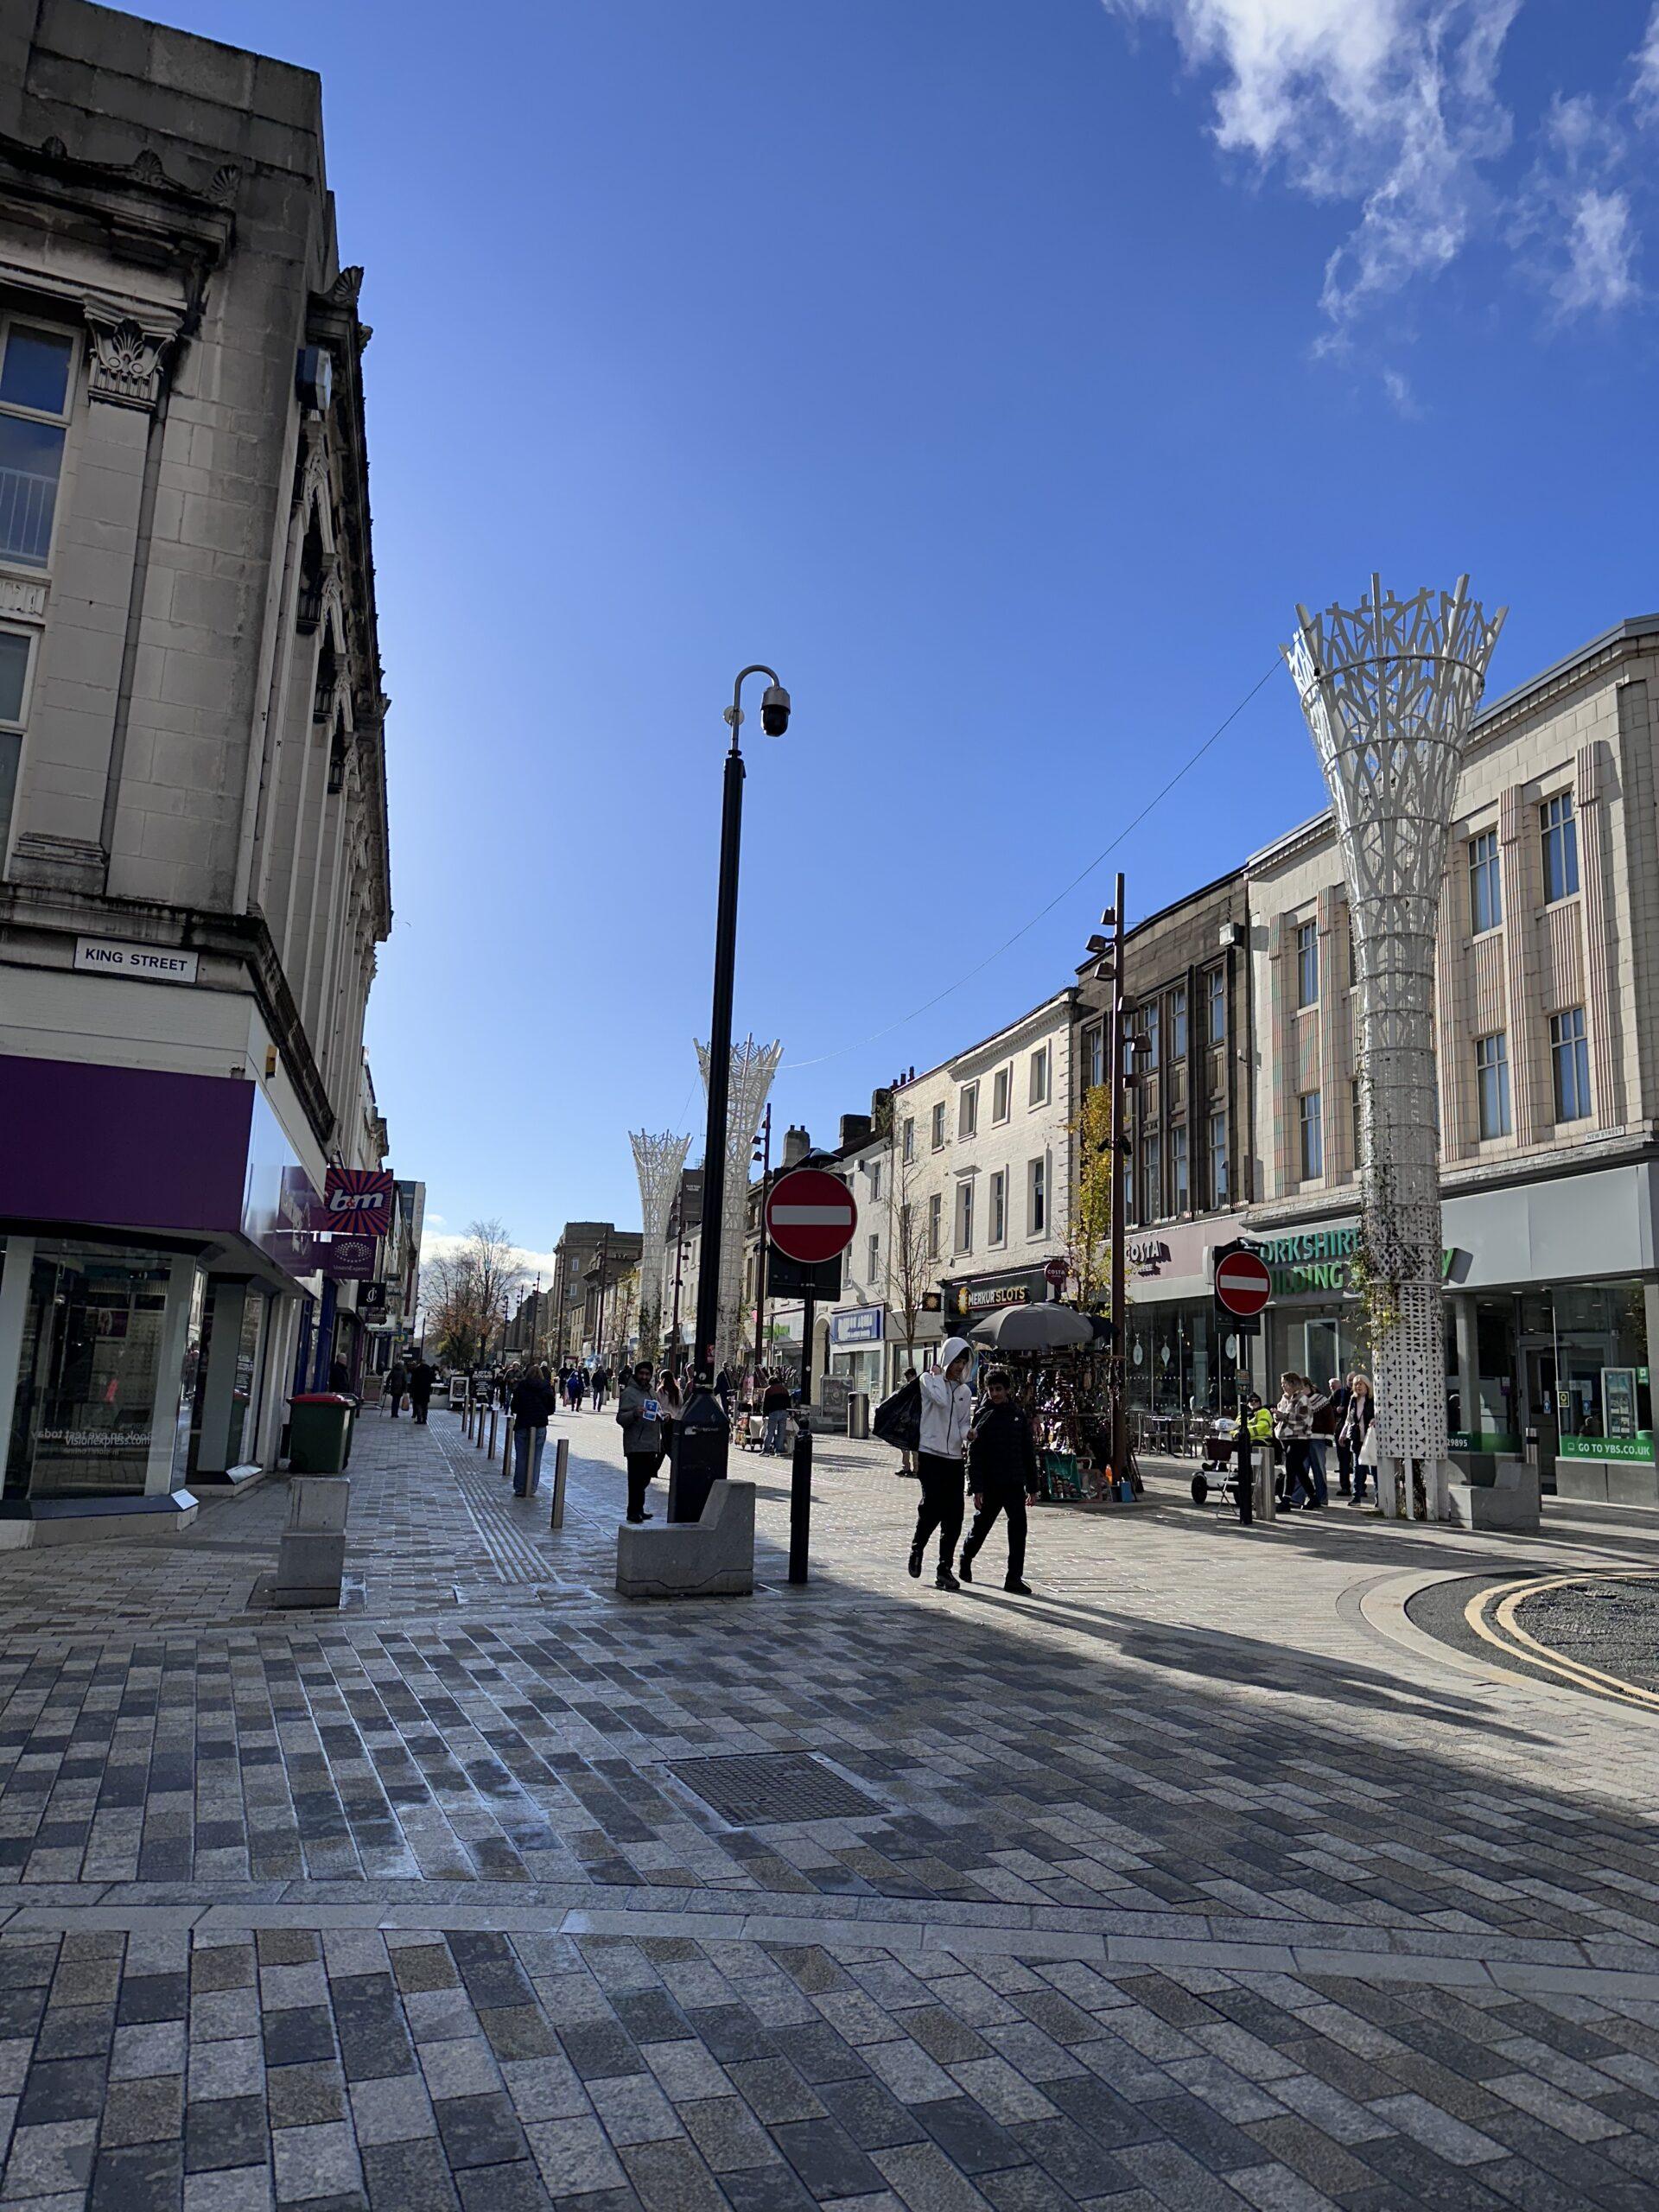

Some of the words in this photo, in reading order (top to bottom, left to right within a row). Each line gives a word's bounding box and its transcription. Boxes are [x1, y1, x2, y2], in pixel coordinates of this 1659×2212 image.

[86, 948, 123, 963] KING
[130, 954, 188, 971] STREET
[1600, 1128, 1623, 1138] STREET
[329, 1189, 384, 1211] b&m
[1124, 1240, 1161, 1262] COSTA
[1260, 1227, 1361, 1263] ORKSHIRE
[968, 1291, 995, 1306] MERKUR
[995, 1287, 1026, 1302] SLOTS
[1592, 1444, 1603, 1452] TO
[1605, 1445, 1650, 1456] YBS.CO.UK
